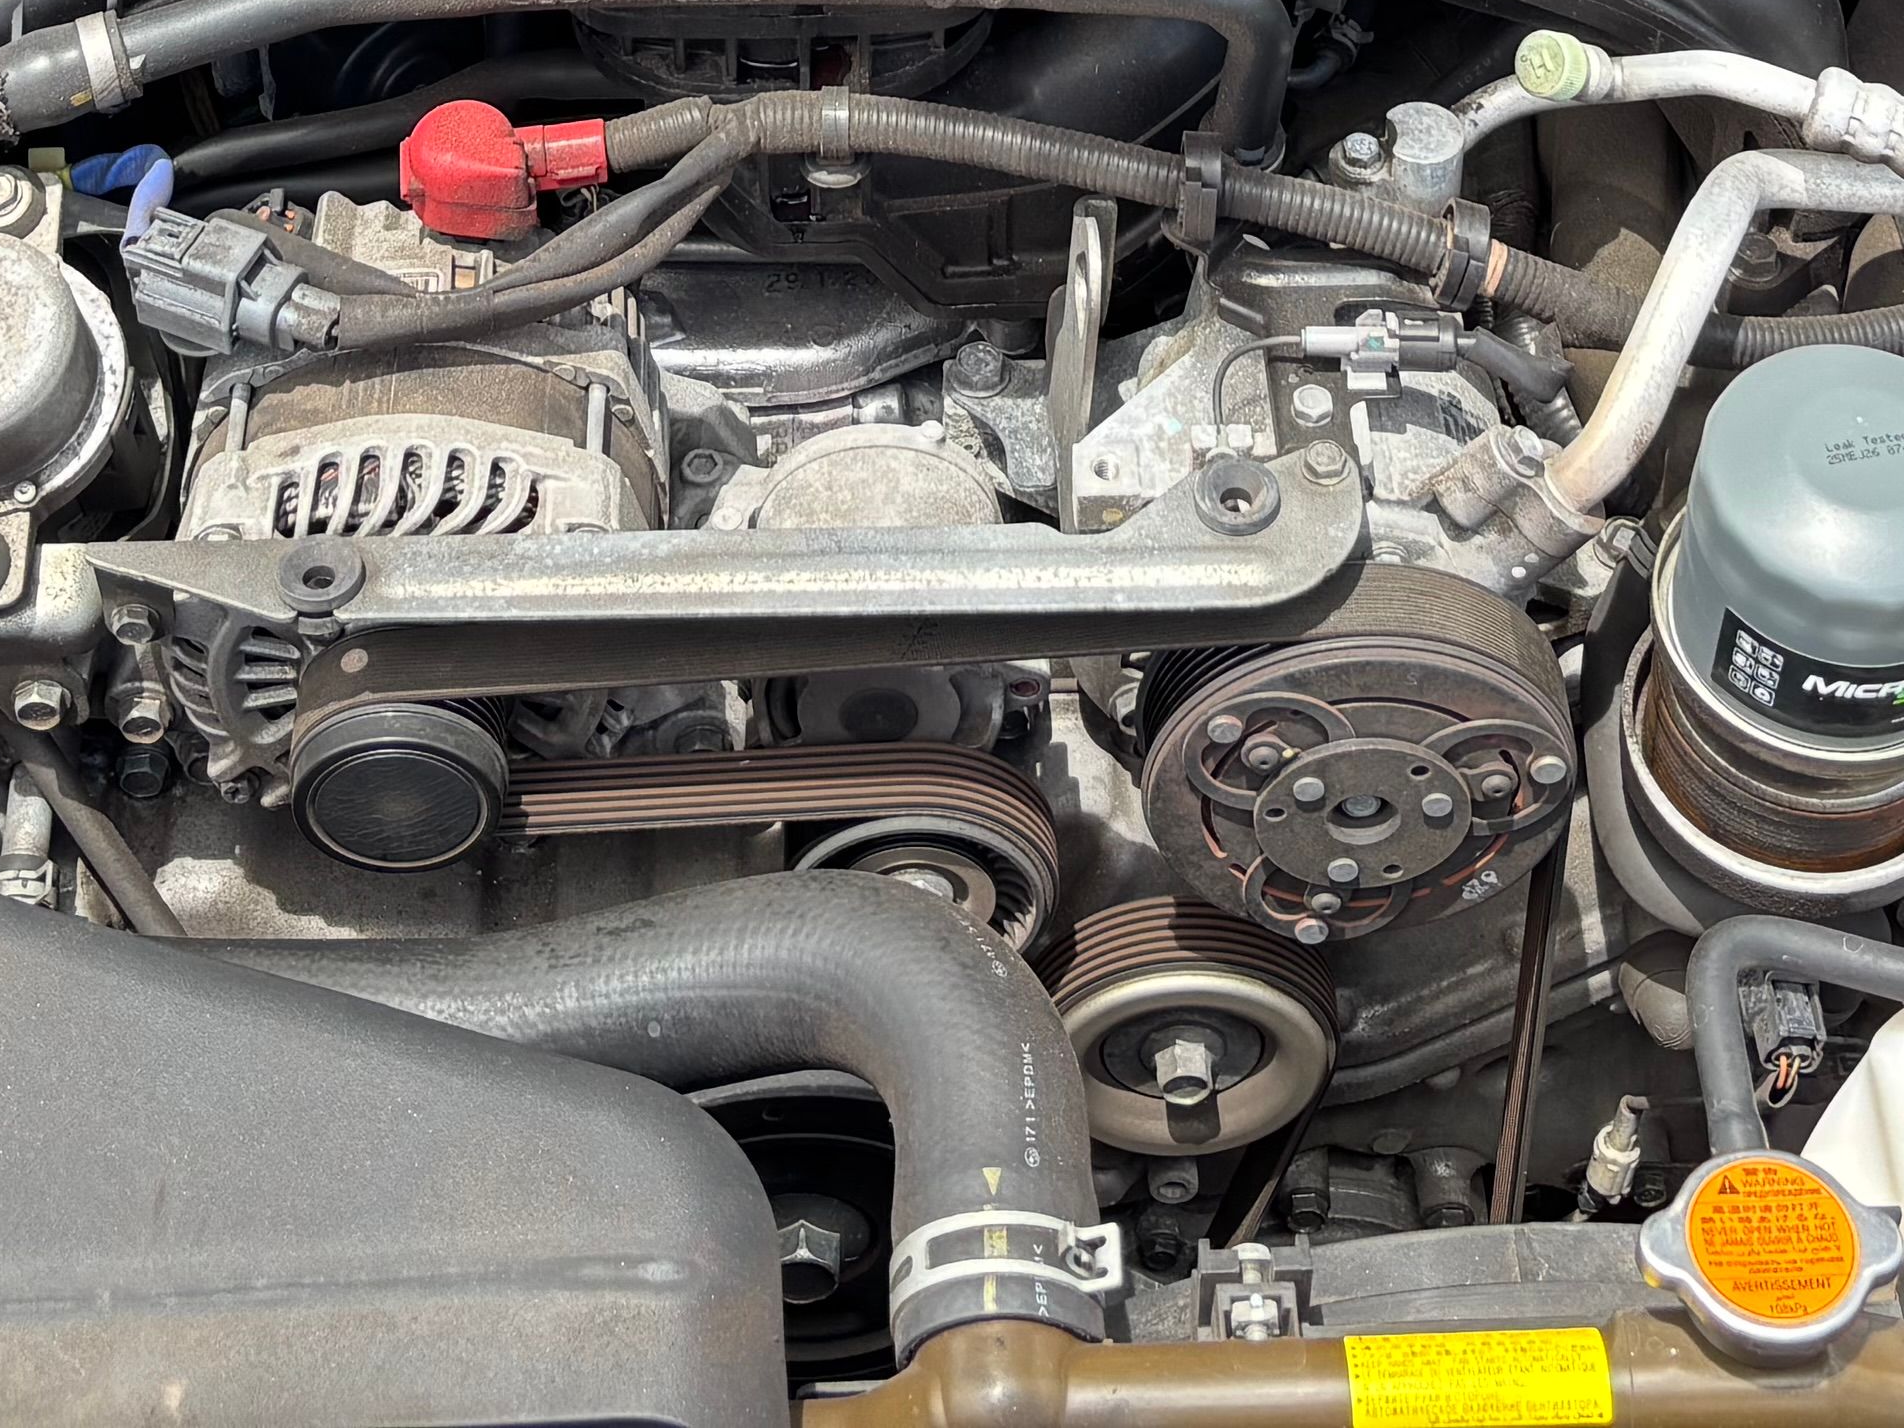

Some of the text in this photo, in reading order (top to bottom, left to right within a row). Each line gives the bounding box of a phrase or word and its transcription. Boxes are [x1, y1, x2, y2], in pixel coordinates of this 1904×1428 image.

[1824, 439, 1855, 453] Leak
[1741, 1176, 1805, 1188] WARNING
[1702, 1222, 1836, 1237] NEVER OPEN WHEN HOT
[1732, 1277, 1831, 1292] AVERTISSEMENT
